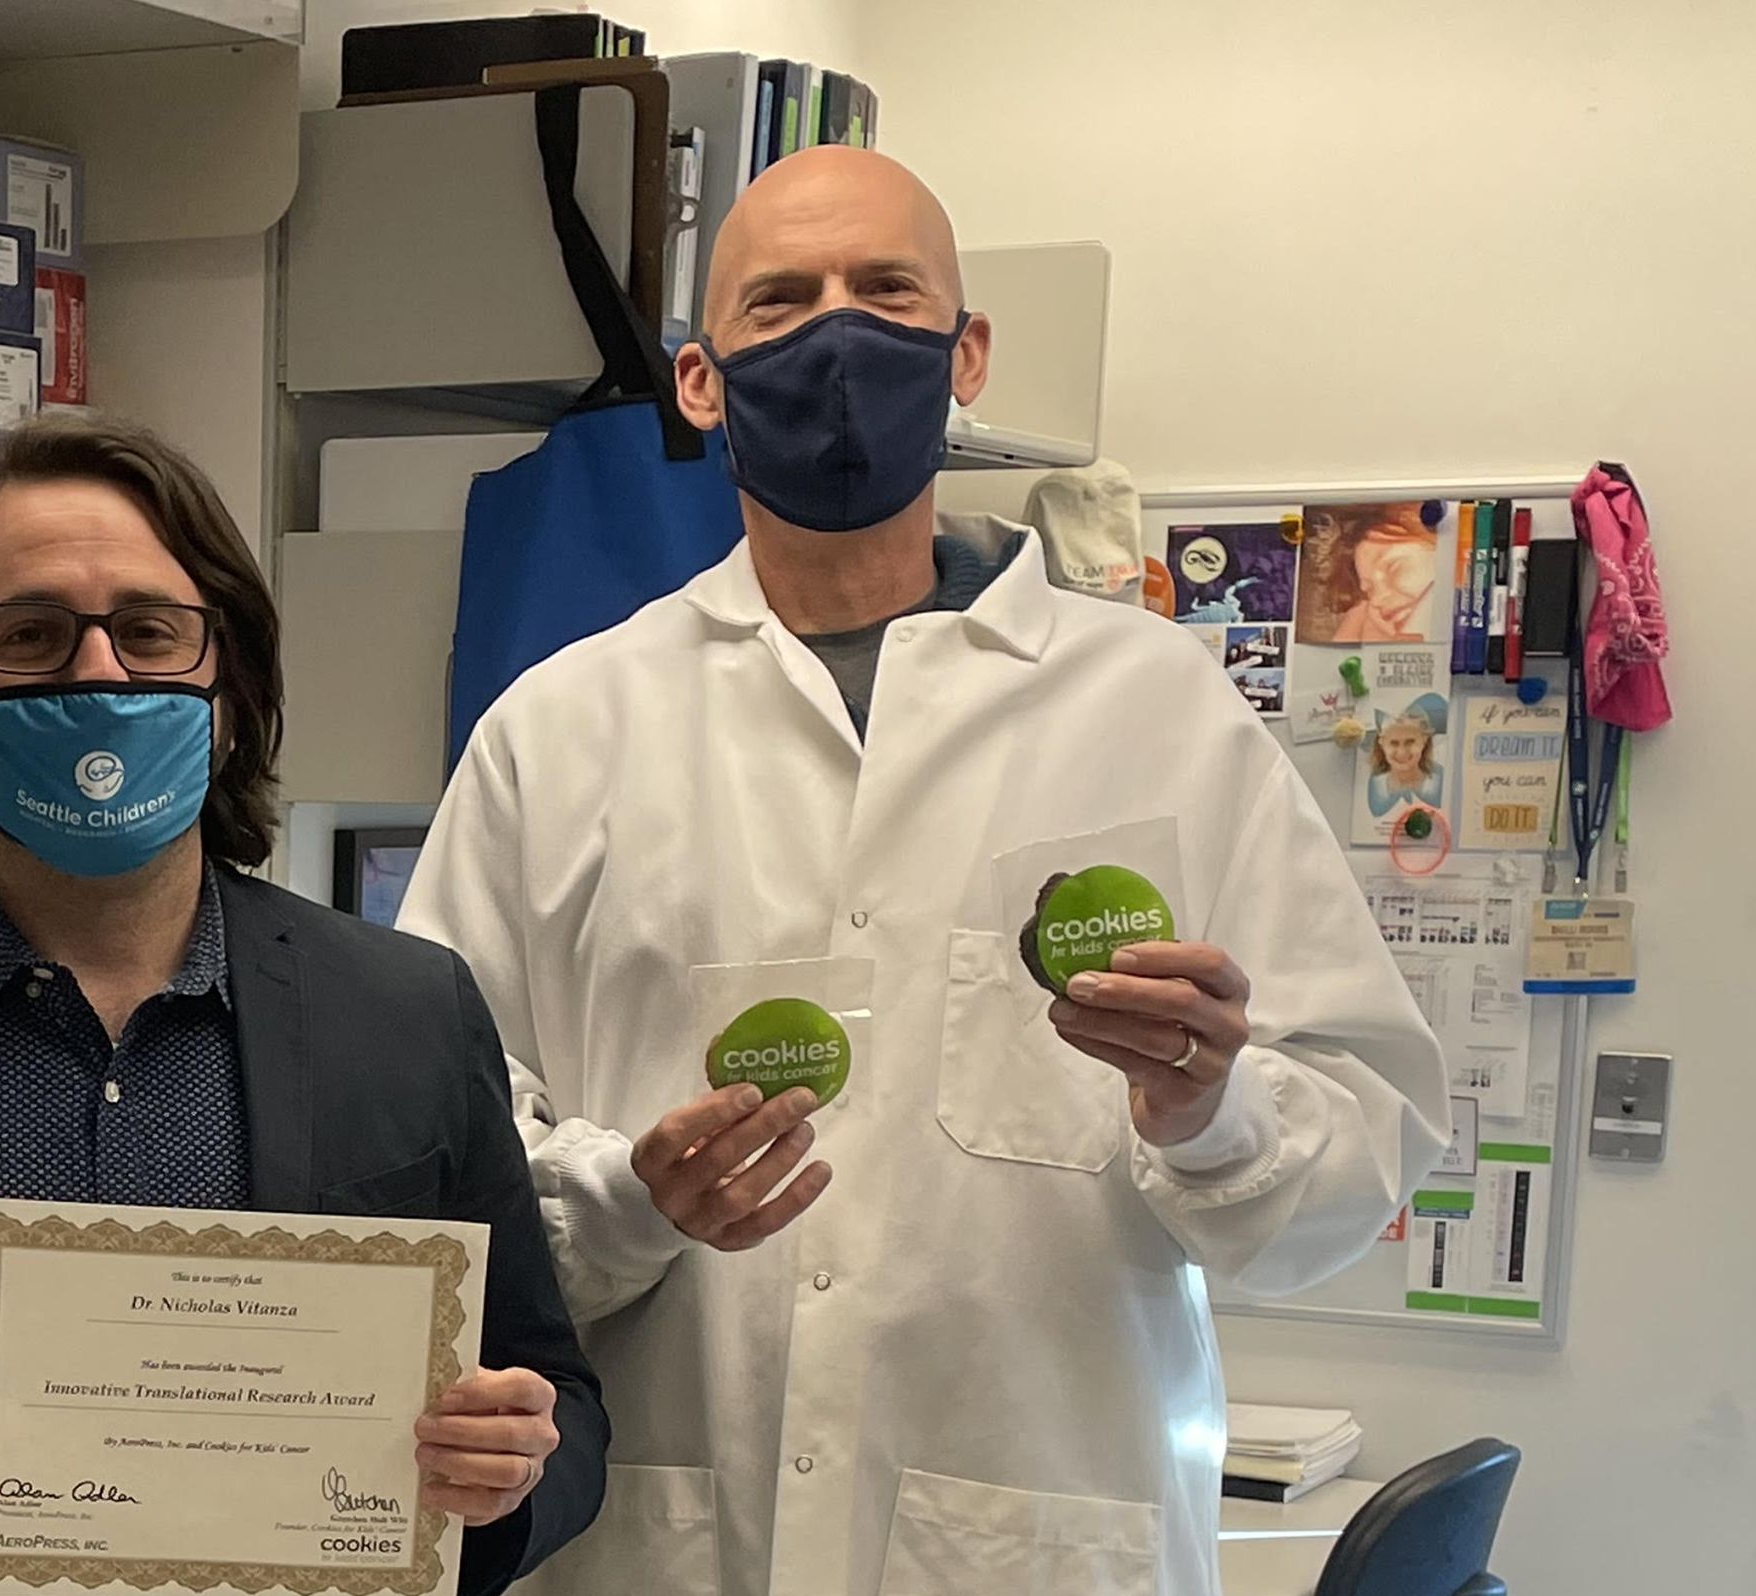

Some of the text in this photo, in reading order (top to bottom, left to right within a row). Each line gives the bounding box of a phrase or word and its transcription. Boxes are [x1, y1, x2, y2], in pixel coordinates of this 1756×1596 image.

[15, 789, 81, 826] Seattle
[1046, 906, 1163, 942] cookies
[724, 1038, 840, 1069] cookies
[783, 1063, 838, 1080] cancer
[131, 1296, 298, 1317] Dr. Nicholas Vitanza
[44, 1380, 376, 1406] Innovative Translational Research Award
[321, 1535, 402, 1553] cookies
